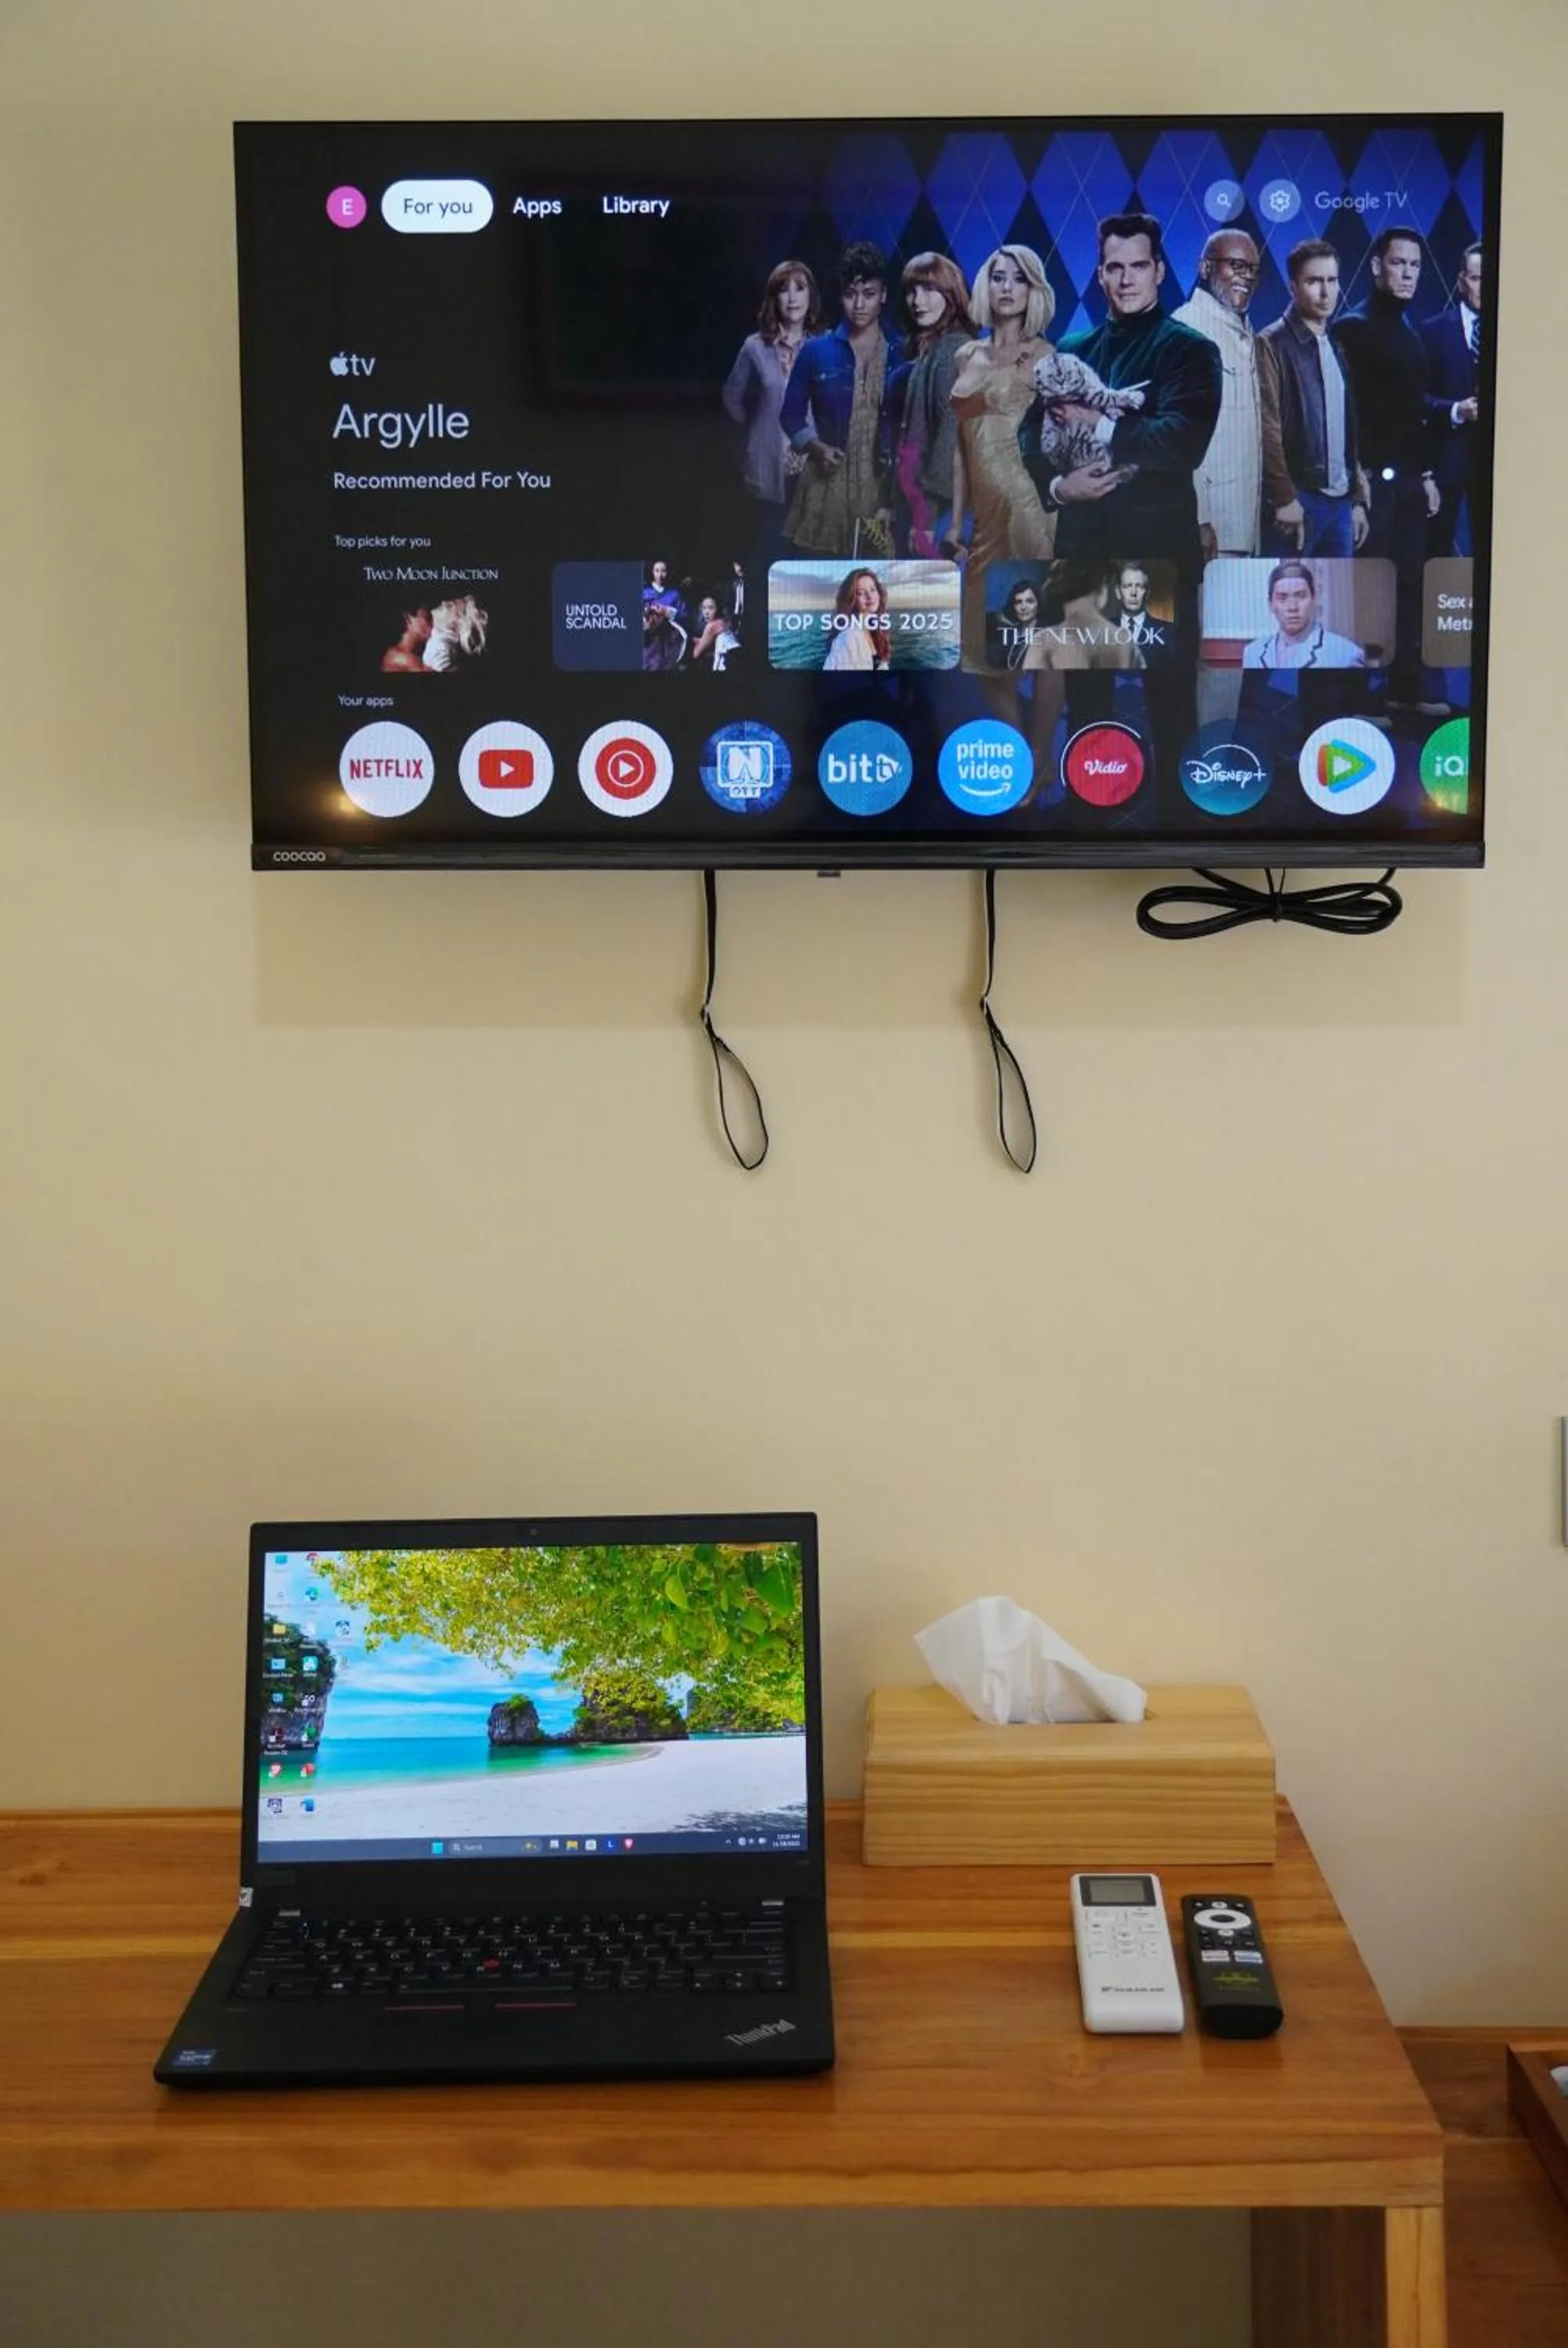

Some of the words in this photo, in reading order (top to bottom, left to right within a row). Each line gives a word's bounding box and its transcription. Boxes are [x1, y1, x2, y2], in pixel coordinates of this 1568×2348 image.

[342, 198, 354, 215] E
[403, 198, 433, 214] For
[438, 202, 473, 218] you
[512, 196, 563, 218] Apps
[602, 196, 671, 218] Library
[1314, 191, 1380, 214] Google
[1384, 191, 1409, 209] TV
[350, 354, 376, 376] tv
[333, 403, 470, 448] Argylle
[333, 472, 476, 489] Recommended
[481, 472, 512, 488] For
[516, 471, 552, 488] You
[335, 535, 356, 549] Top
[358, 535, 388, 549] picks
[390, 535, 408, 547] for
[409, 538, 431, 549] you
[565, 603, 618, 617] UNTOLD
[1437, 593, 1466, 609] Sex
[565, 617, 627, 629] SCANDAL
[774, 613, 813, 631] TOP
[820, 613, 892, 630] SONGS
[901, 613, 954, 630] 2025
[998, 627, 1043, 646] THE
[1045, 627, 1100, 646] NEW
[1104, 627, 1166, 646] LOOK
[337, 695, 365, 707] Your
[365, 697, 394, 708] apps
[956, 740, 1016, 762] prime
[350, 758, 424, 780] NETFLIX
[957, 761, 1014, 780] video
[1084, 758, 1127, 776] Vidio
